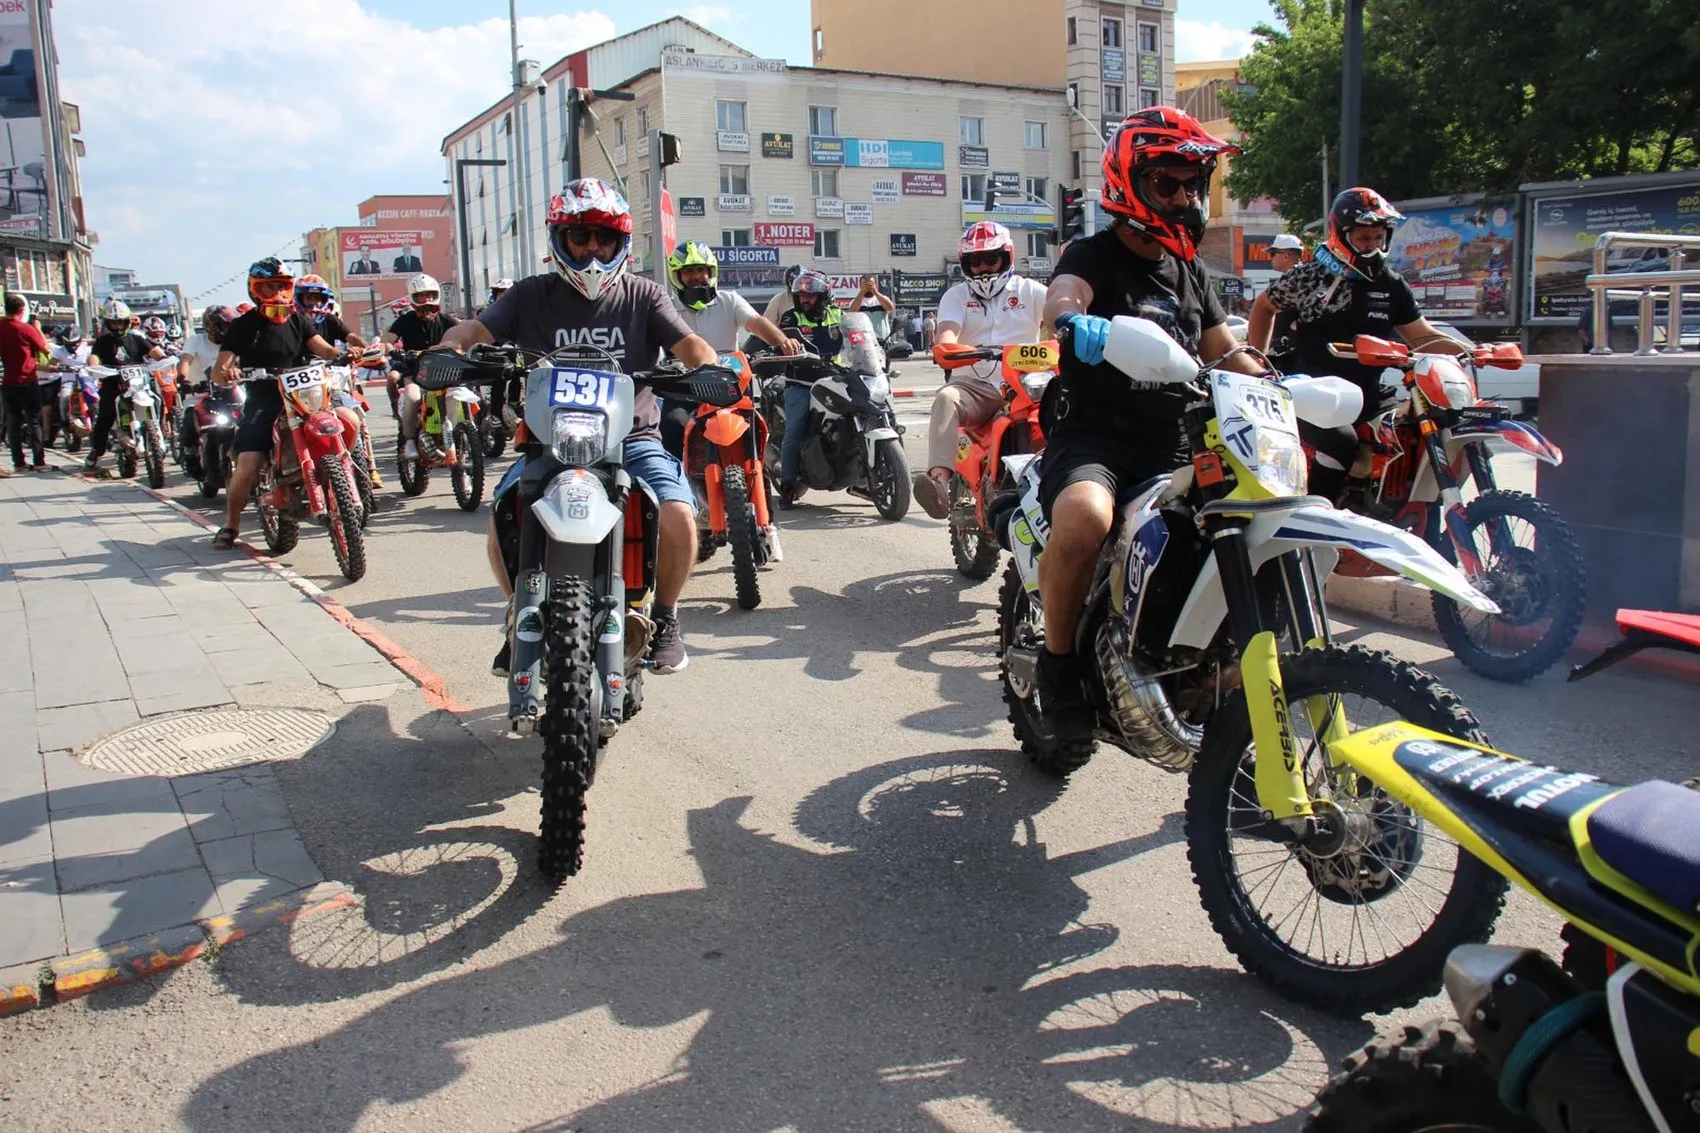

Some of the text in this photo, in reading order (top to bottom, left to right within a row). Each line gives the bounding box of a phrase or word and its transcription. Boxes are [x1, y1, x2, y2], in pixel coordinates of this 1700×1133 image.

[764, 141, 792, 149] AVUKAT
[861, 143, 887, 154] HDI
[861, 155, 887, 165] Sigorta
[759, 225, 811, 238] 1.NOTER
[728, 246, 777, 261] SİGORTA
[832, 277, 860, 289] ZAN
[900, 280, 946, 288] ACCO SHOP
[555, 327, 625, 349] NASA
[1020, 346, 1047, 359] 606
[121, 368, 142, 380] 551
[286, 368, 322, 388] 583
[554, 371, 610, 408] 531
[1514, 771, 1601, 810] MOTUL
